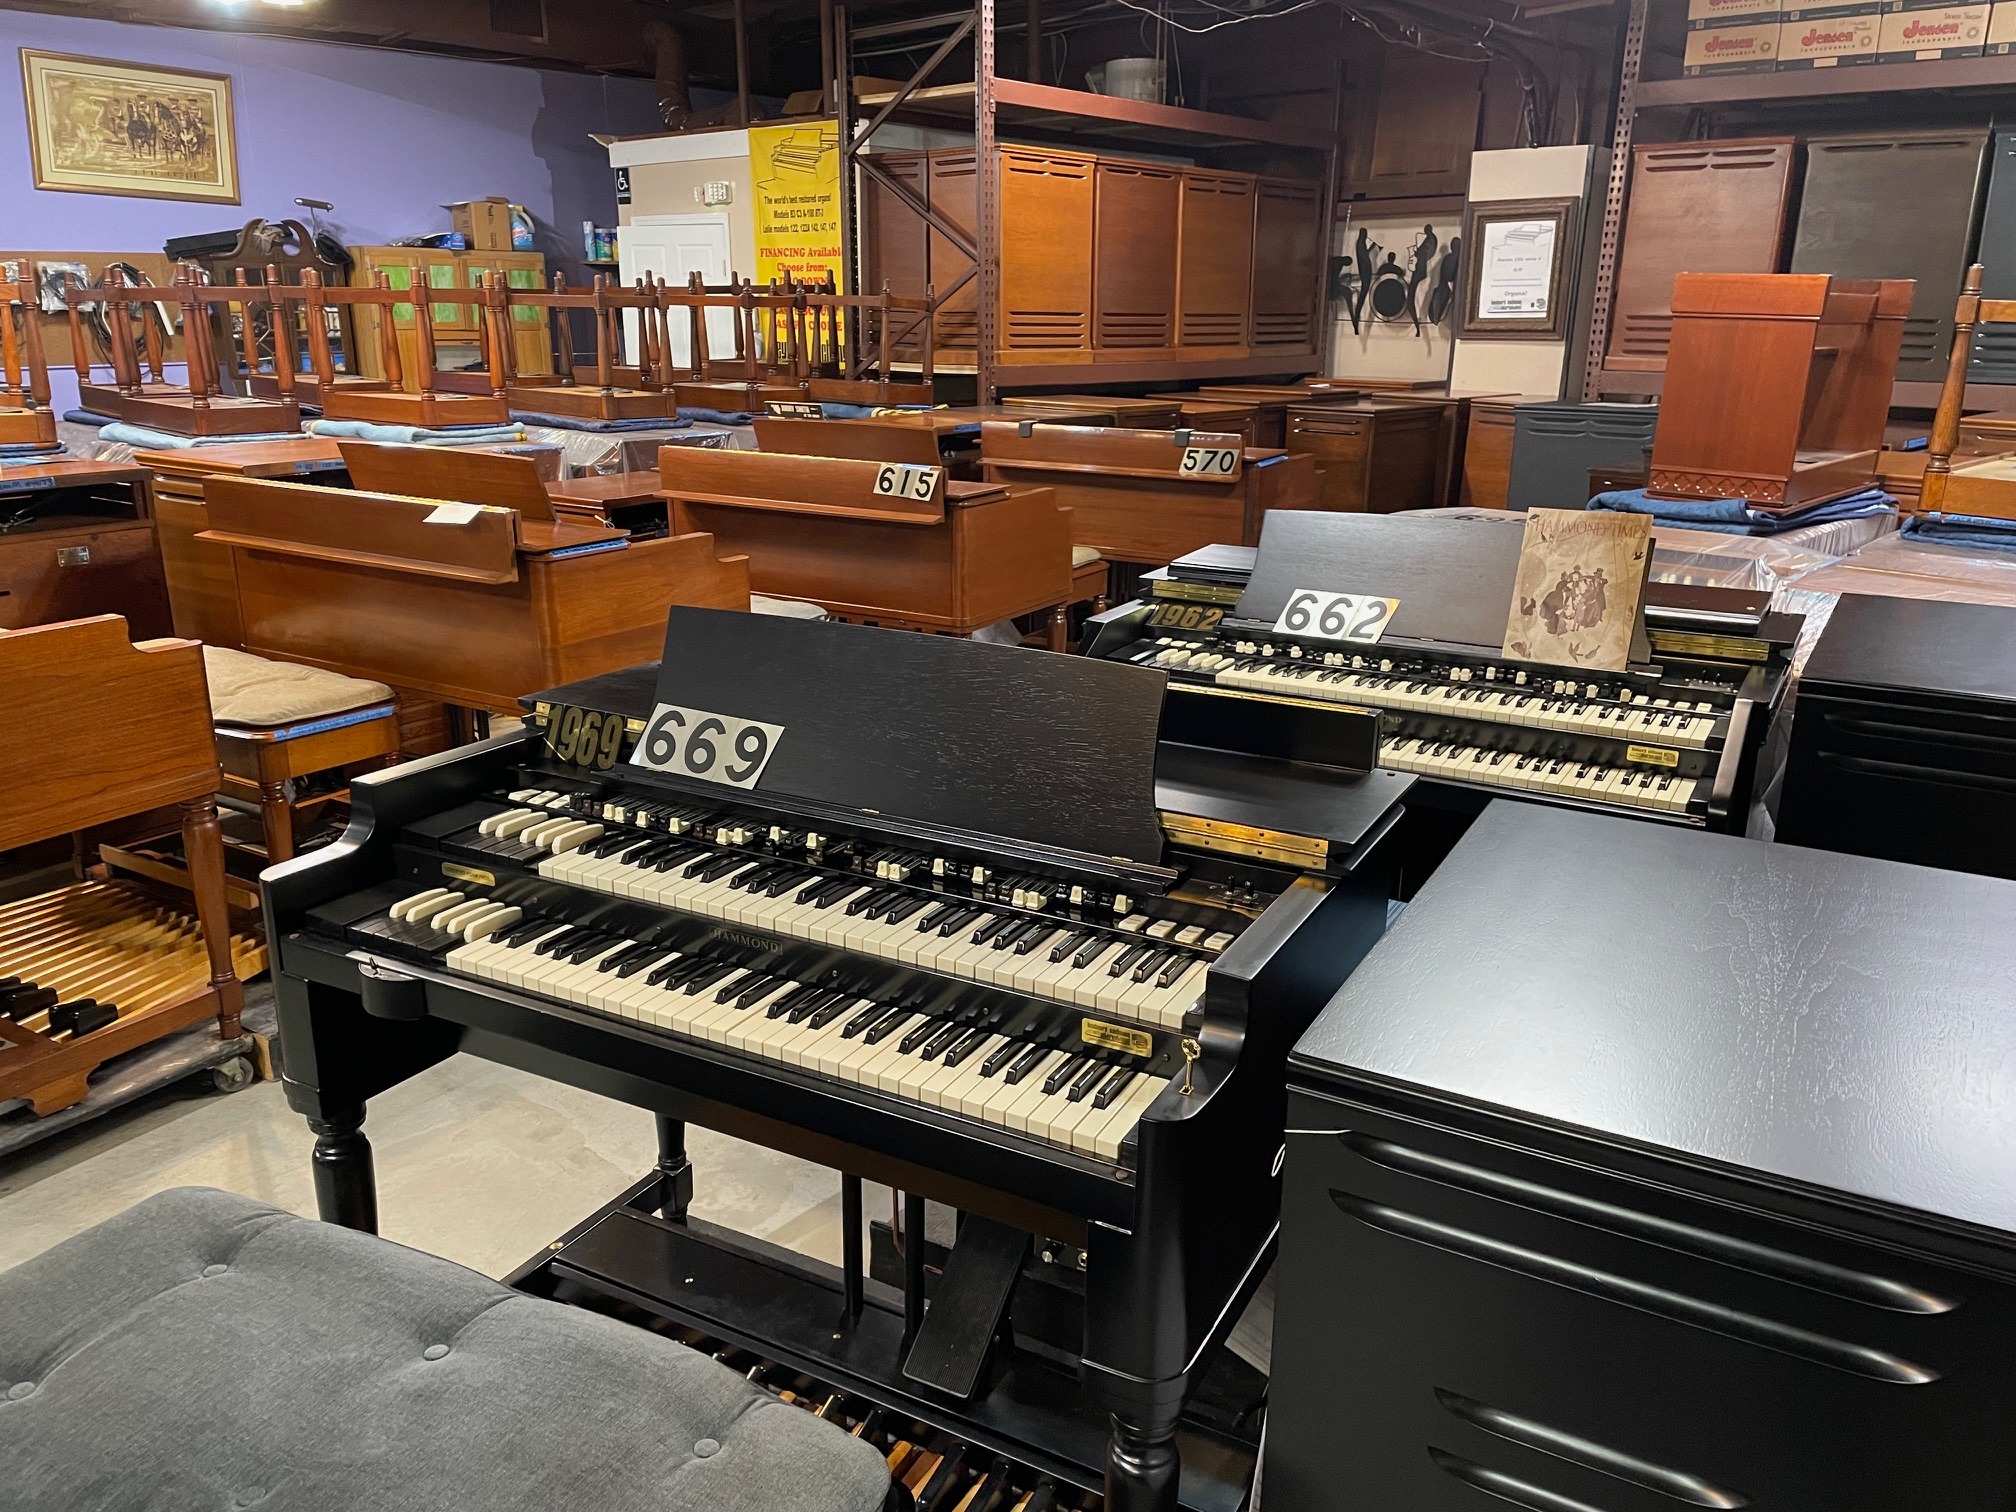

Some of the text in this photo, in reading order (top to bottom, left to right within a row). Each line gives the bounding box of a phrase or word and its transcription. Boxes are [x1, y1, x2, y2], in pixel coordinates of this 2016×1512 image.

[1801, 28, 1854, 47] Jensen
[1902, 20, 1960, 39] Jensen
[1704, 35, 1755, 53] Jensen
[760, 246, 842, 258] FINANCING Availabl
[777, 262, 828, 272] Choose from:
[1183, 449, 1234, 473] 570
[879, 467, 934, 498] 615
[1535, 519, 1607, 537] HAMMOND
[1611, 521, 1648, 539] TIMES
[1151, 603, 1225, 631] 1962
[1284, 593, 1388, 639] 662
[543, 704, 624, 771] 1969
[645, 710, 768, 783] 669
[713, 928, 779, 953] HAMMOND
